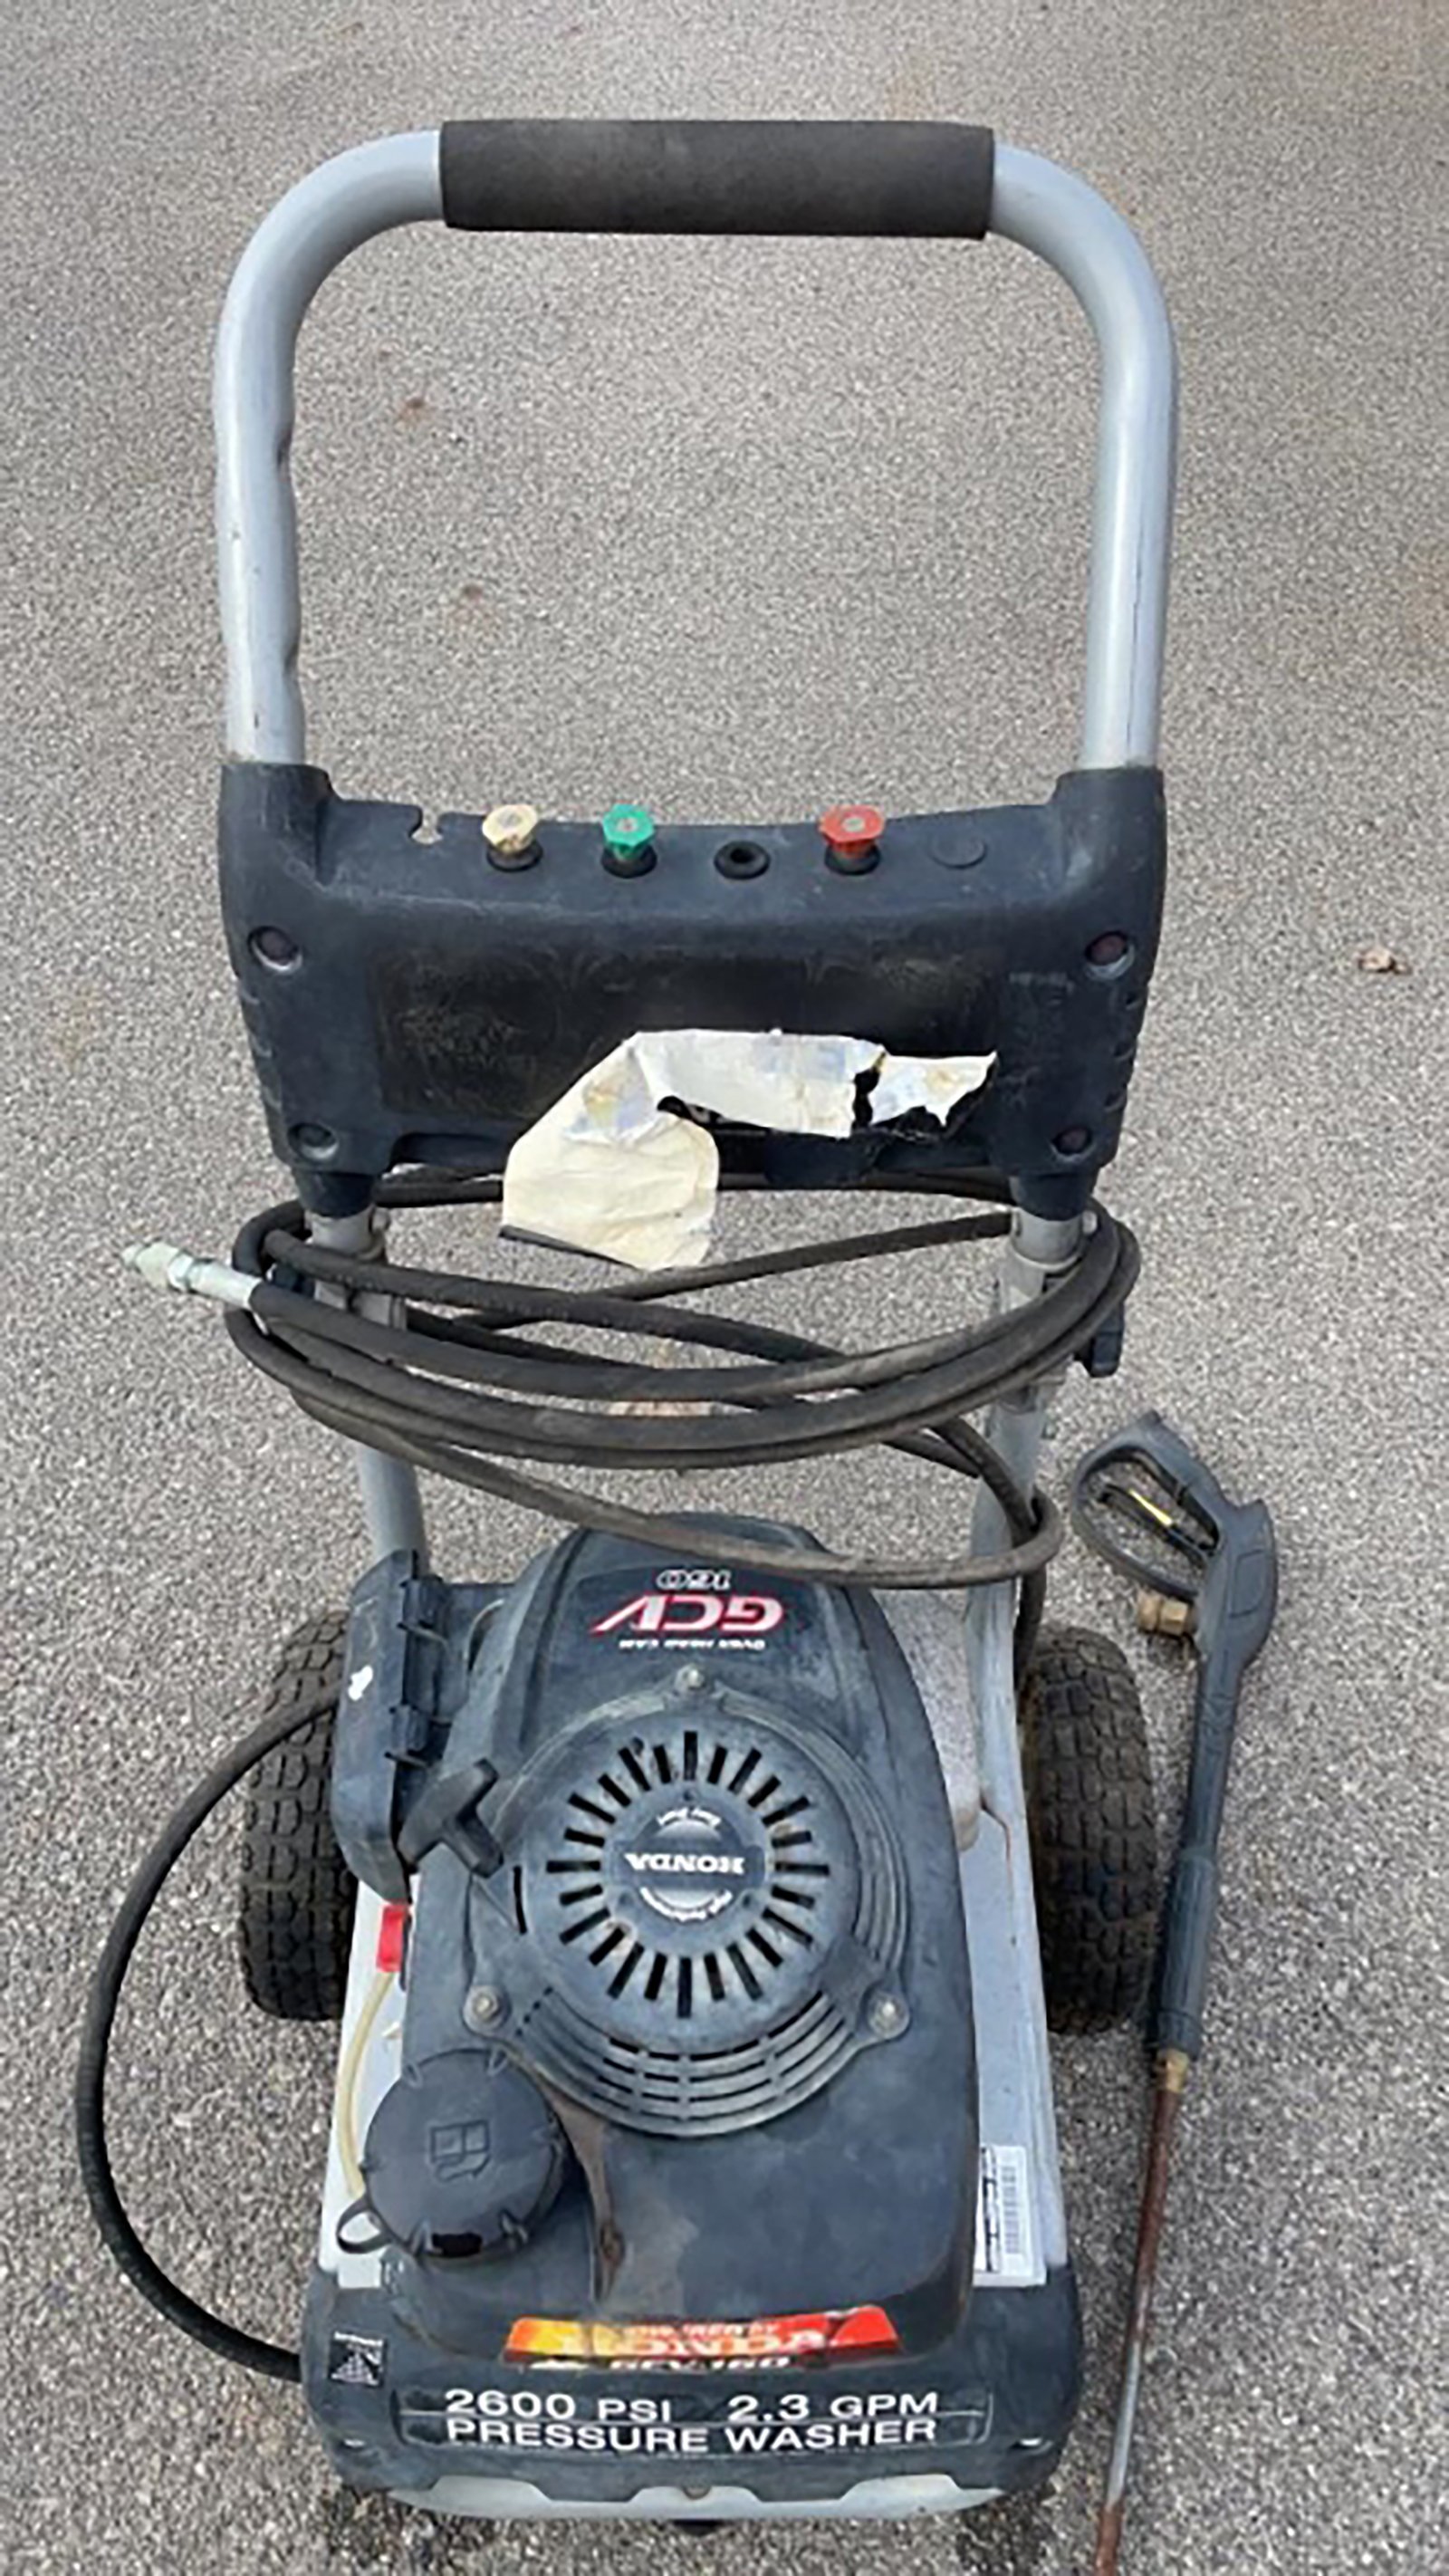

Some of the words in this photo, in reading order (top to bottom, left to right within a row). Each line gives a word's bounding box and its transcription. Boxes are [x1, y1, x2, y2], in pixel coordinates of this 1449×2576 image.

[657, 1570, 731, 1590] 160
[592, 1593, 783, 1632] GCV
[623, 1853, 746, 1875] HONDA
[444, 2389, 577, 2420] 2600
[598, 2399, 671, 2423] PSI
[728, 2394, 811, 2423] 2.3
[830, 2392, 938, 2419] GPM
[446, 2417, 709, 2453] PRESSURE
[724, 2419, 938, 2453] WASHER
